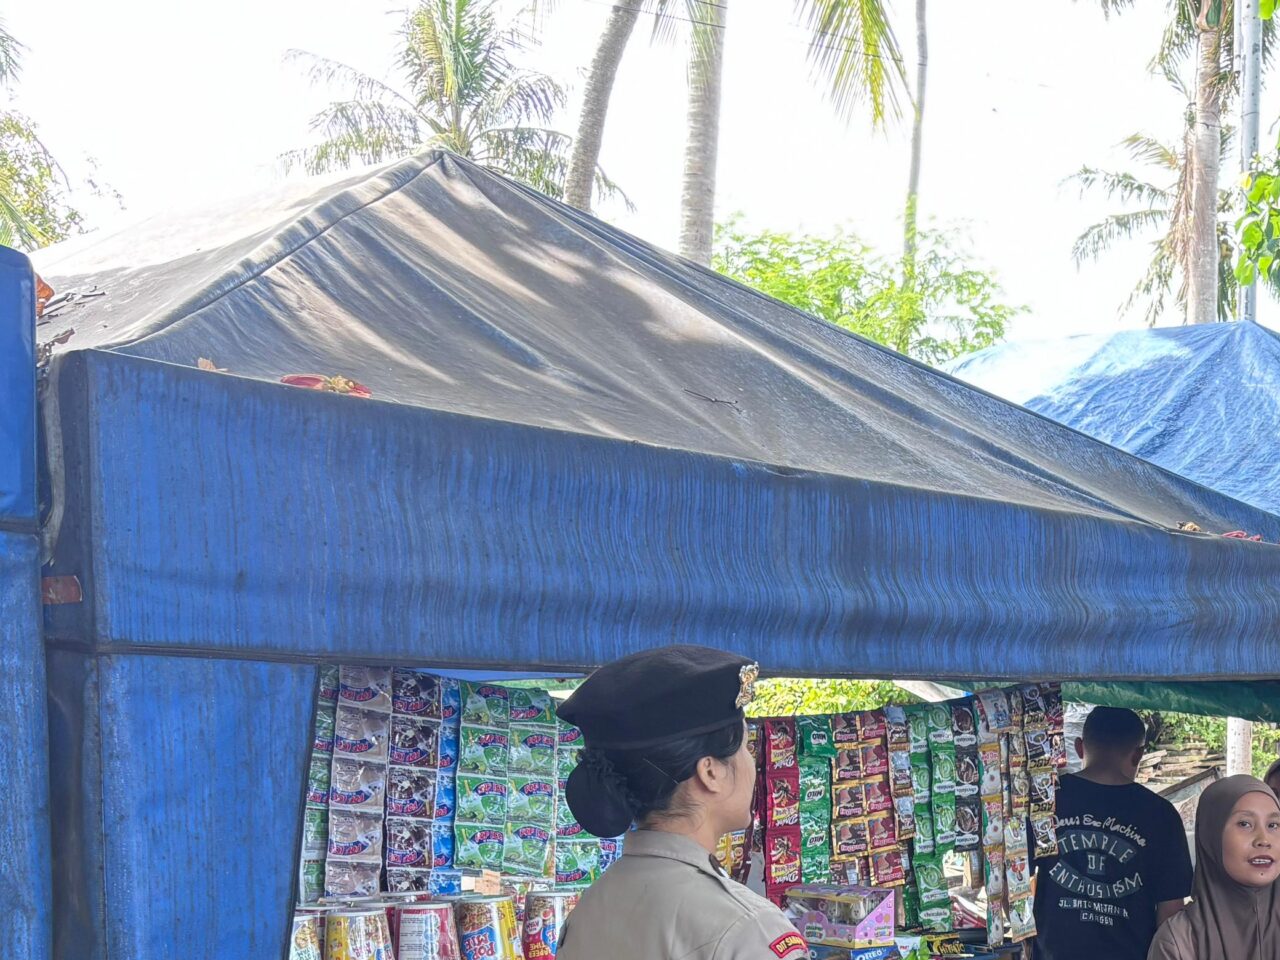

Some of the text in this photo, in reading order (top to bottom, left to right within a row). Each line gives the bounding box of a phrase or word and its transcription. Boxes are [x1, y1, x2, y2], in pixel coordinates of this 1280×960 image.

[812, 733, 827, 741] MILO
[1029, 756, 1051, 768] ABC
[807, 788, 823, 799] MILO
[1032, 801, 1054, 812] ABC
[809, 833, 825, 844] MILO
[1058, 833, 1134, 863] TEMPLE
[1088, 855, 1106, 871] OF
